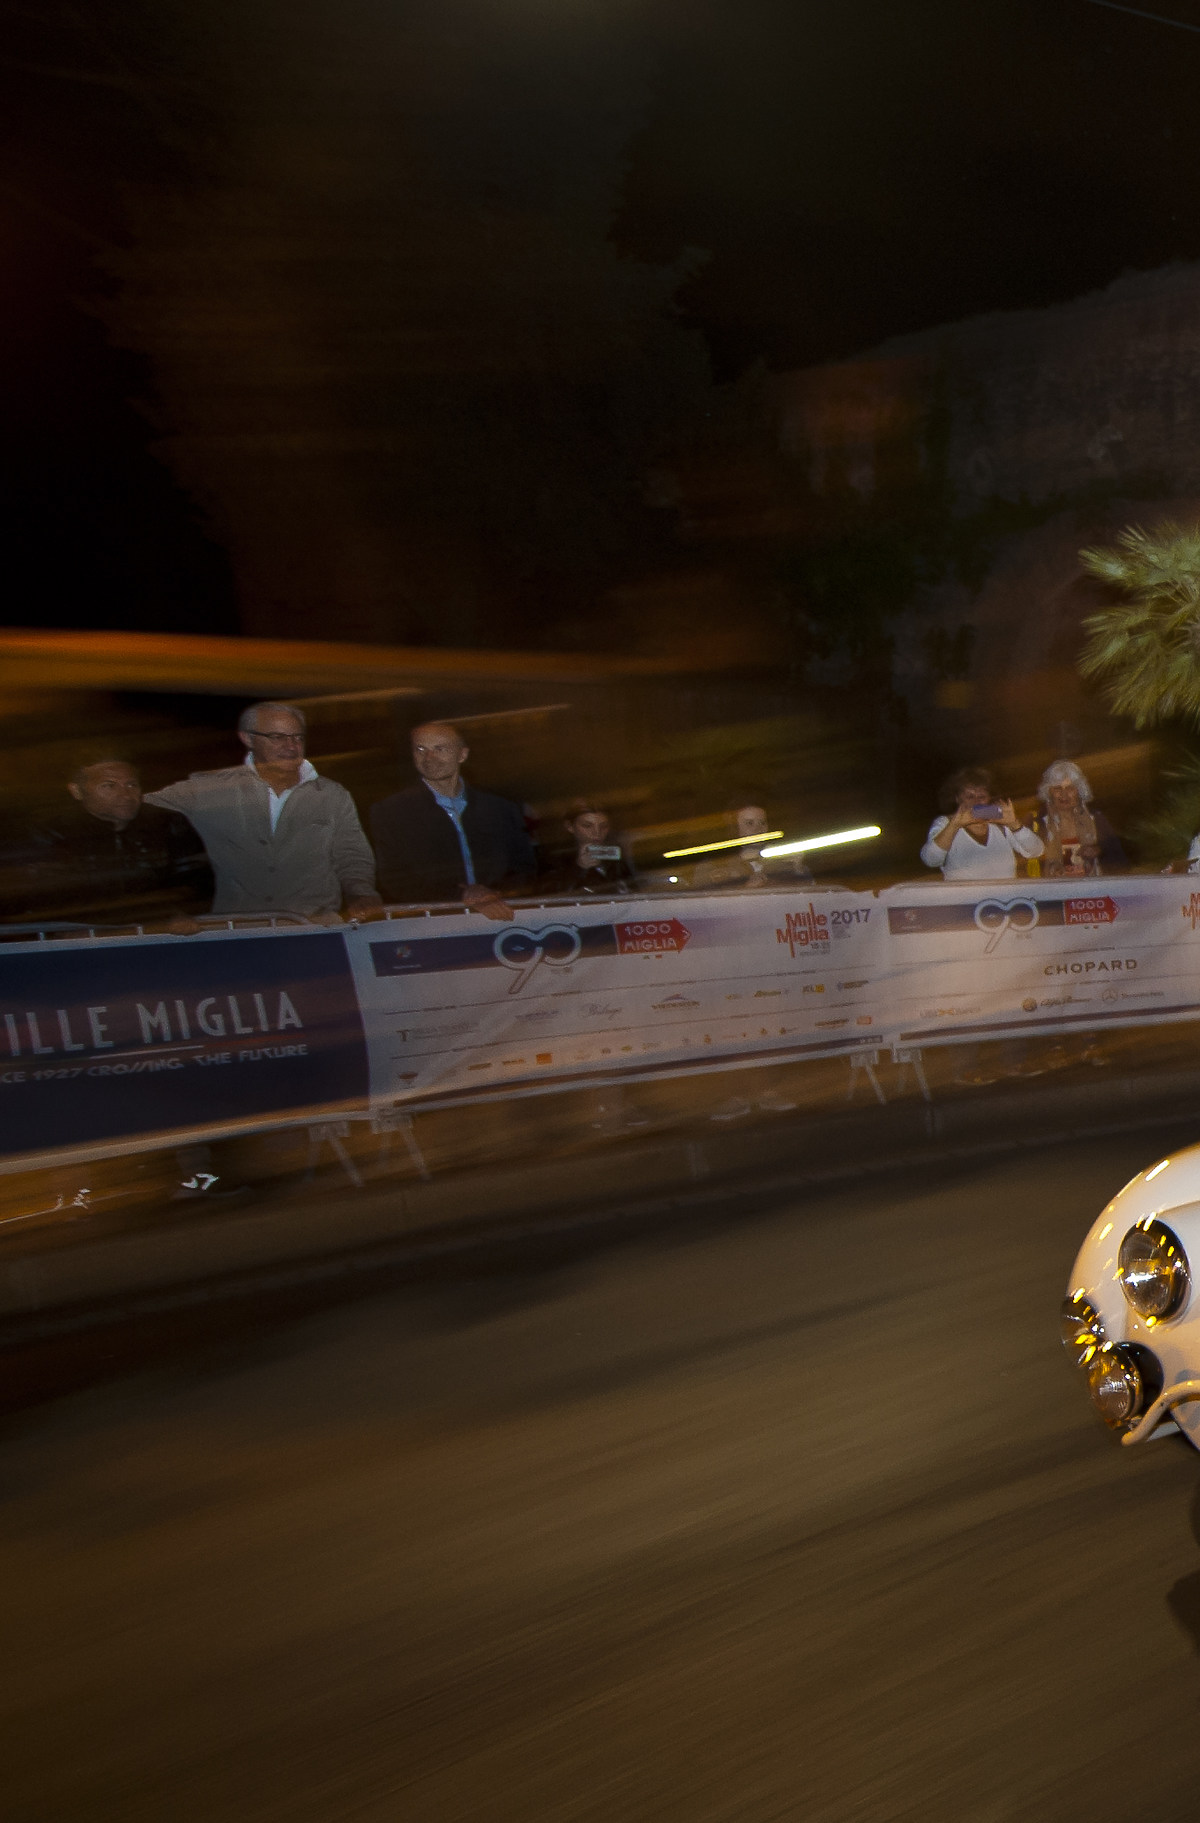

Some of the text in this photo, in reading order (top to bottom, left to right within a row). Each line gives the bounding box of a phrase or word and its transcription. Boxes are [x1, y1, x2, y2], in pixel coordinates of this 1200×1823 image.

[1070, 900, 1105, 911] 1000
[785, 902, 872, 928] Mille 2017
[1070, 911, 1111, 923] MIGLIA
[624, 922, 672, 936] 1000
[623, 937, 678, 951] MIGLIA
[776, 926, 830, 958] Miglia
[1044, 958, 1138, 976] CHOPARD
[4, 991, 303, 1057] ILLE MIGLIA
[32, 1067, 82, 1082] 1927
